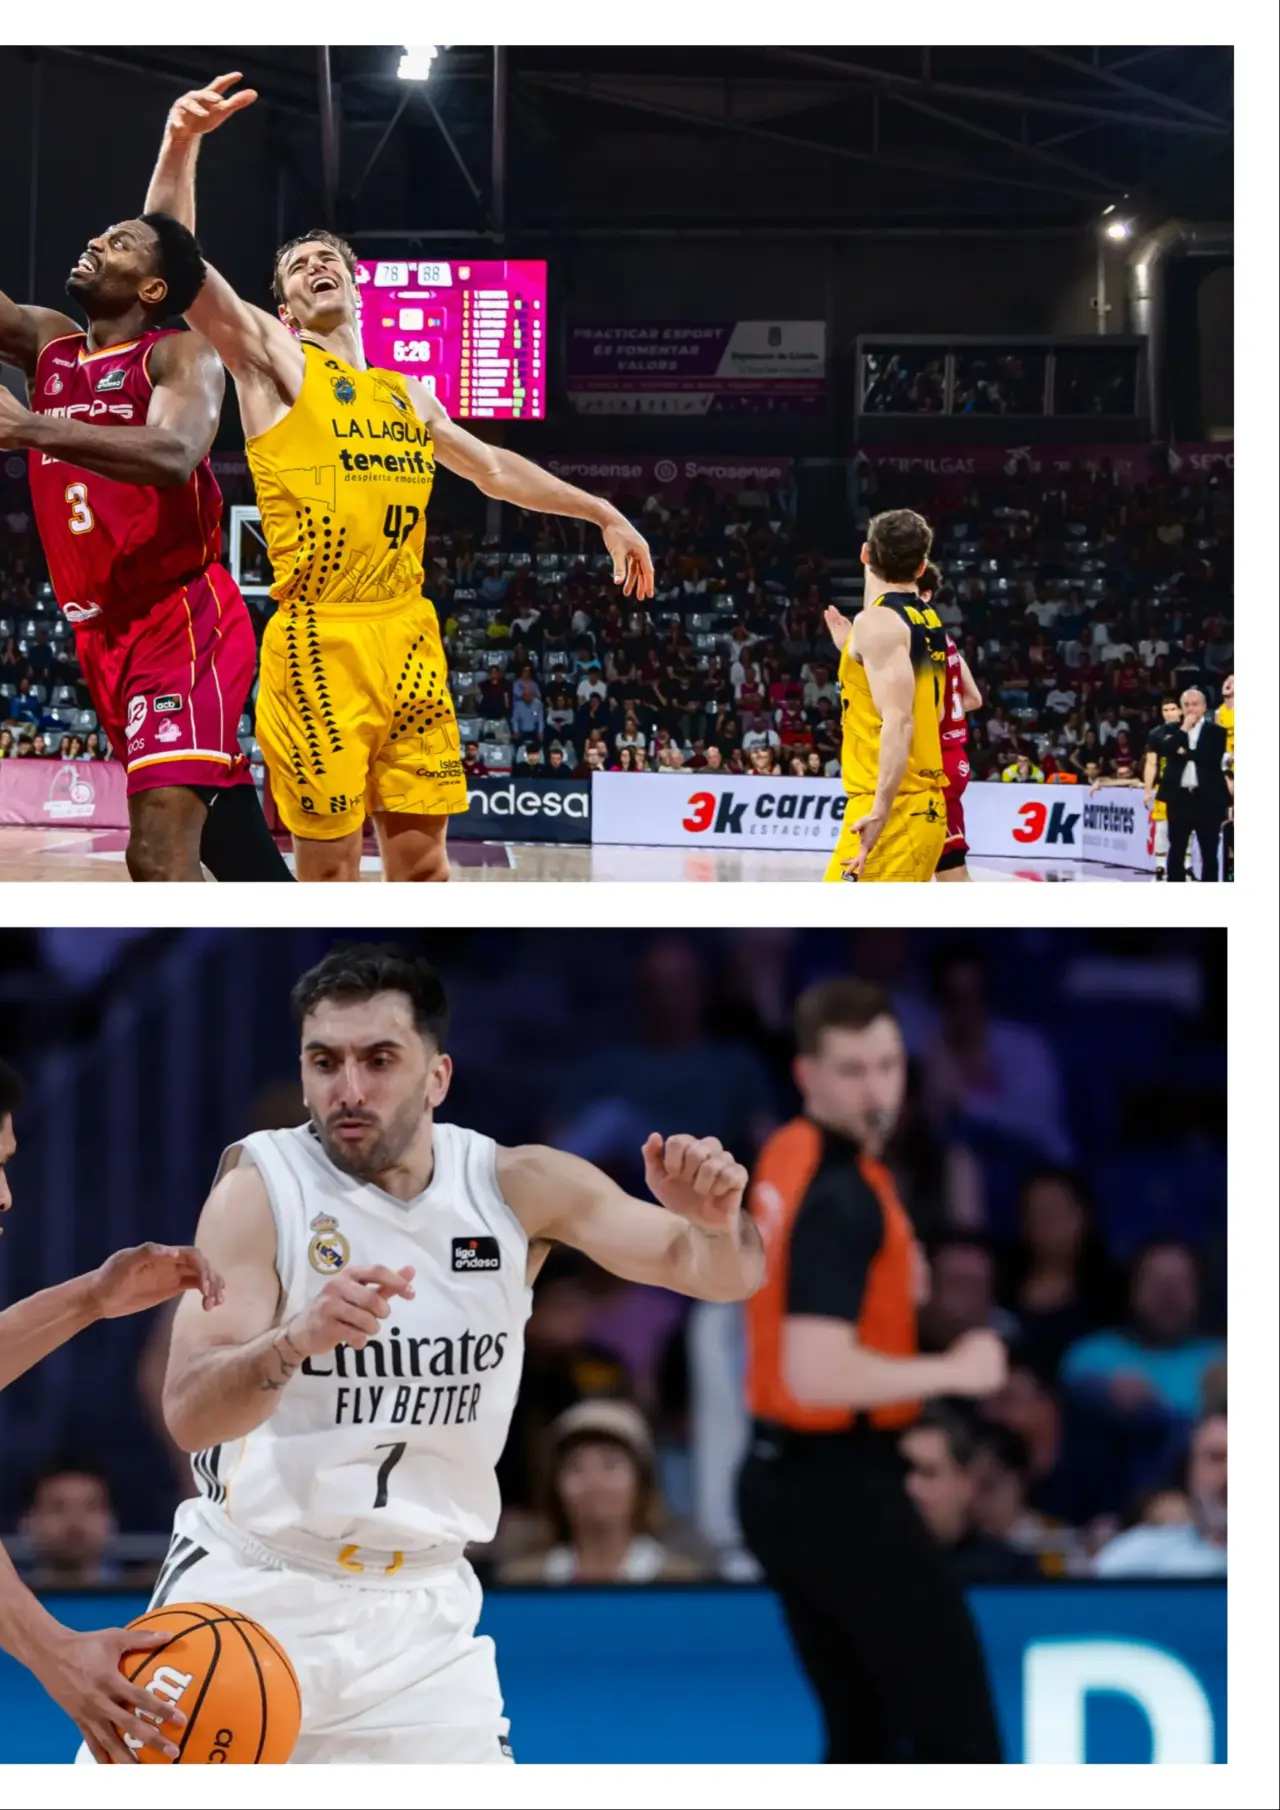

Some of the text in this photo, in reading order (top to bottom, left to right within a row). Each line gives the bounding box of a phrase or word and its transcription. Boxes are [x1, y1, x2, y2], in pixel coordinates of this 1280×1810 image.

[35, 399, 135, 419] OPOS
[332, 418, 364, 439] LA
[395, 474, 433, 485] emocion
[65, 482, 95, 535] 3
[383, 504, 420, 550] 42
[156, 700, 176, 710] acb
[439, 758, 463, 770] Islas
[467, 784, 589, 818] ndesa
[682, 791, 749, 834] 3k
[749, 822, 821, 838] ESTACIÓ
[1011, 801, 1081, 845] 3k
[455, 1246, 476, 1260] liga
[455, 1256, 499, 1269] endesa
[336, 1382, 482, 1426] FLY BETTER
[372, 1441, 407, 1510] 7
[209, 1728, 233, 1764] ac
